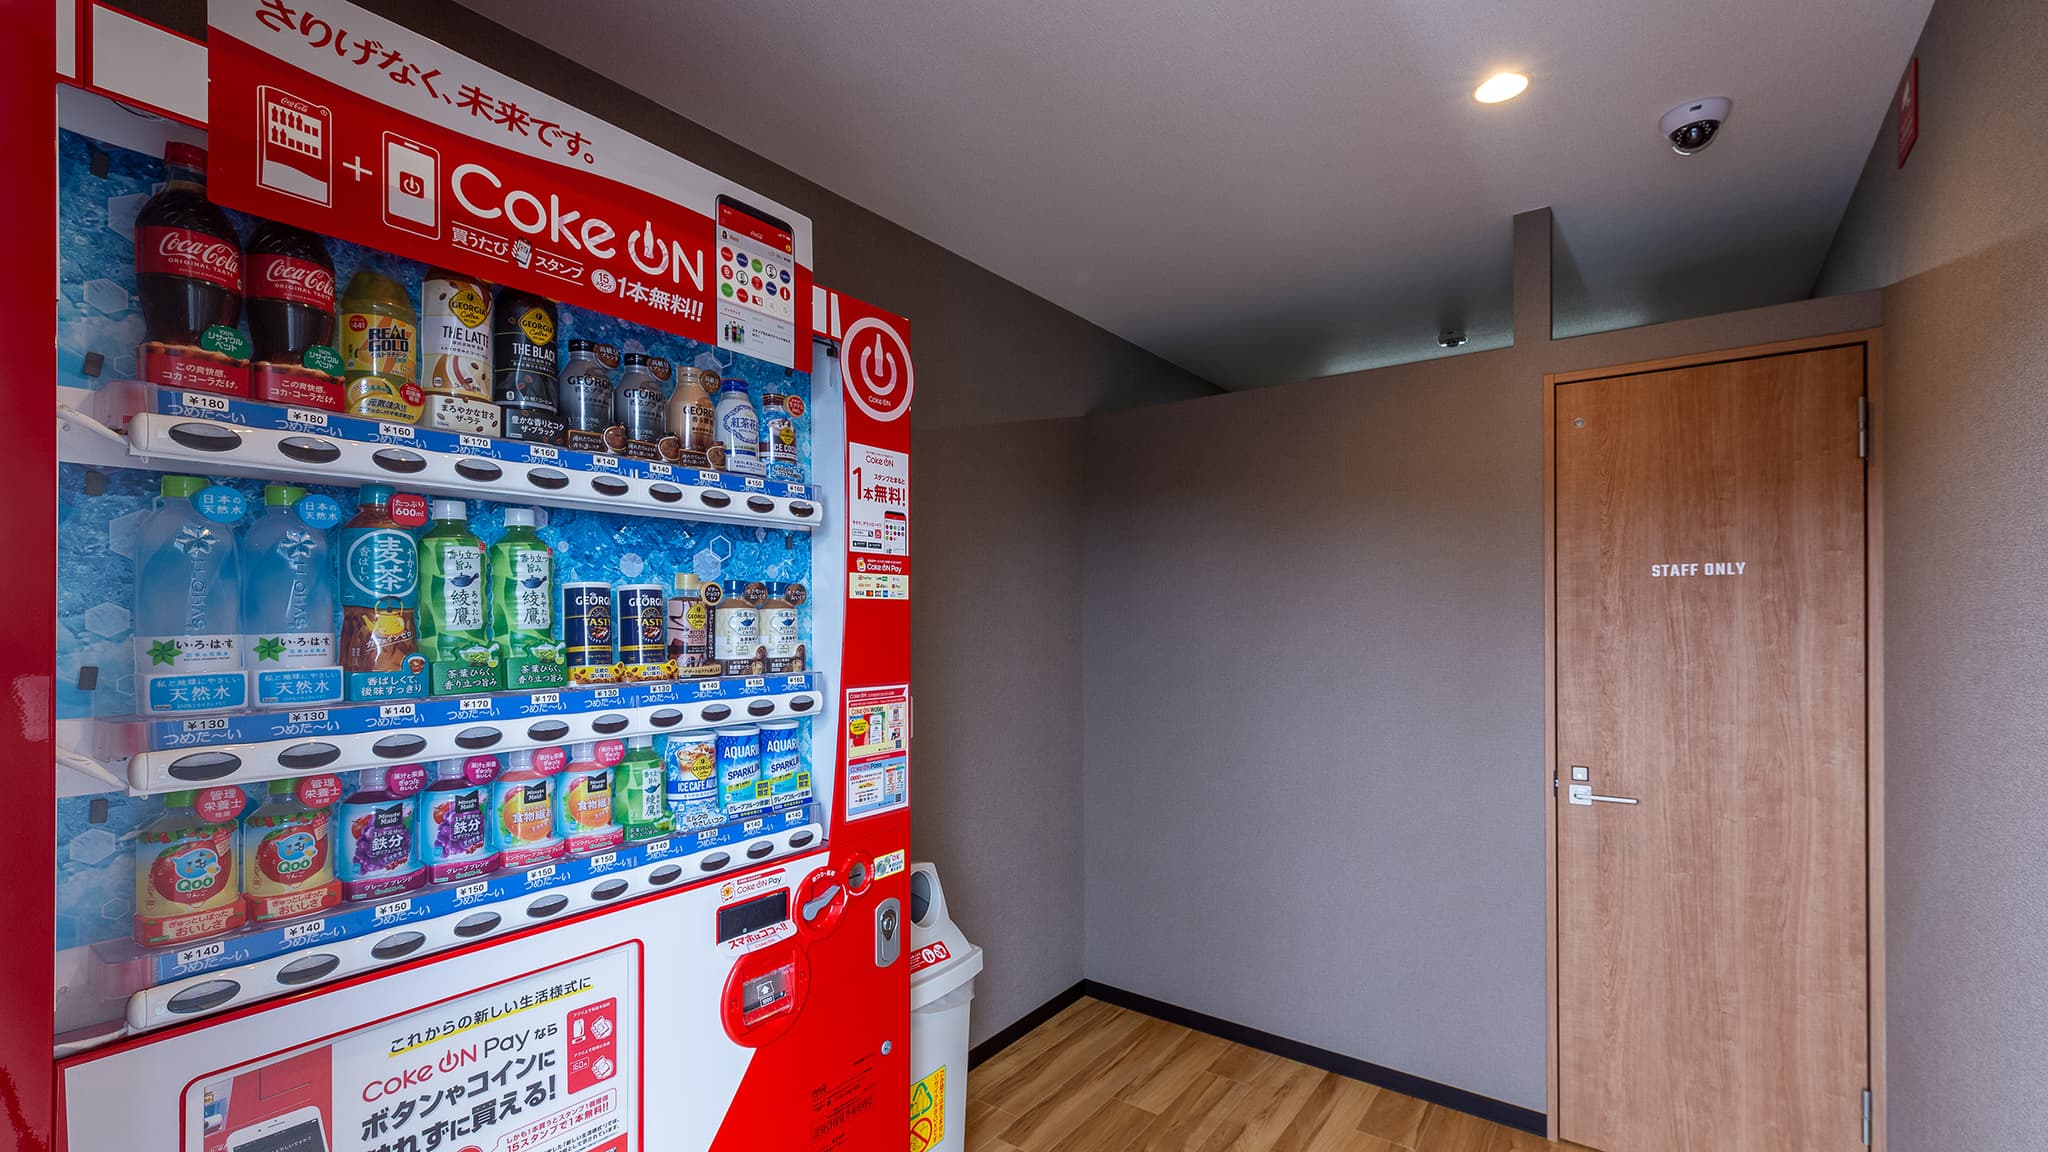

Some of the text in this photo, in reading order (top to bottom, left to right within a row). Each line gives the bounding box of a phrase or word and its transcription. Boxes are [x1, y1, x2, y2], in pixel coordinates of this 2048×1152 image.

[256, 0, 595, 165] さりげなく、未来です。
[451, 163, 616, 259] Coke
[452, 226, 509, 256] 買うたび
[159, 231, 239, 274] Coca-Cola
[167, 256, 210, 272] ORIGINAL
[535, 256, 585, 279] スタンプ
[266, 258, 336, 298] Coca-Cola
[598, 272, 610, 284] 15
[274, 282, 312, 295] ORIGINAL
[451, 300, 487, 316] GEORGIA
[459, 310, 480, 320] Coffee
[368, 325, 409, 340] REAL
[442, 325, 463, 341] THE
[522, 320, 553, 334] GEORGIA
[207, 331, 244, 346] リサイクル
[528, 329, 549, 338] Coffee
[214, 341, 238, 352] ペット
[368, 340, 409, 352] GOLD
[512, 342, 531, 357] THE
[309, 351, 339, 365] リサイクル
[175, 362, 227, 379] この爽快感。
[314, 360, 335, 370] ペット
[189, 395, 225, 410] ¥180
[293, 411, 324, 425] ¥180
[441, 404, 496, 421] まろやかな甘さ
[455, 414, 481, 426] ザ・ラテ
[511, 415, 565, 432] 豊かな香りとコク
[383, 425, 411, 437] ¥160
[462, 436, 488, 447] ¥170
[533, 447, 556, 458] ¥160
[596, 456, 616, 466] ¥140
[865, 454, 883, 466] Coke
[652, 464, 670, 474] ¥140
[701, 473, 718, 481] ¥160
[873, 473, 905, 485] スタンプたまると
[203, 493, 242, 505] 日本の
[394, 498, 425, 509] たっぷり
[203, 504, 243, 515] 天然水
[304, 501, 337, 512] 日本の
[395, 507, 425, 518] 600ml
[304, 511, 338, 522] 天然水
[448, 549, 481, 561] 香り立つ
[519, 552, 549, 564] 香り立つ
[358, 547, 370, 582] 香ばしい
[373, 536, 403, 592] 麦茶
[455, 560, 473, 571] 旨み
[526, 562, 543, 573] 旨み
[866, 563, 881, 571] Coke
[891, 564, 903, 574] Pay
[1651, 561, 1746, 577] STAFF ONLY
[471, 590, 481, 625] あやたか
[540, 592, 549, 625] あやたか
[447, 669, 496, 679] 茶葉ひらく、
[519, 664, 562, 674] 茶葉ひらく、
[156, 676, 241, 688] 私と地球にやさしい
[264, 672, 338, 683] 私と地球にやさしい
[367, 673, 419, 686] 香ばしくて、
[517, 673, 565, 685] 香り立つ旨み
[275, 679, 331, 695] 天然水
[361, 683, 423, 697] 後味すっきり
[445, 678, 498, 691] 香り立つ旨み
[169, 685, 231, 703] 天然水
[534, 694, 557, 703] ¥170
[463, 699, 489, 709] ¥170
[292, 711, 325, 721] ¥130
[384, 706, 411, 715] ¥140
[187, 719, 225, 730] ¥130
[692, 764, 712, 772] GEORGIA
[311, 777, 335, 789] 管理
[591, 784, 604, 792] Maid
[210, 789, 237, 800] 管理
[304, 786, 340, 800] 栄養士
[526, 788, 545, 797] Minute
[528, 794, 543, 802] Maid
[203, 797, 242, 813] 栄養士
[457, 798, 478, 806] Minute
[460, 803, 475, 811] Maid
[378, 811, 401, 821] Minute
[380, 817, 399, 825] Maid
[685, 813, 709, 823] ミルクの
[692, 816, 725, 828] やさしいコク
[453, 819, 481, 836] 鉄分
[746, 820, 761, 829] ¥140
[700, 831, 717, 839] ¥130
[371, 835, 404, 852] 鉄分
[649, 841, 668, 851] ¥140
[277, 858, 310, 874] Qoo
[593, 855, 614, 866] ¥150
[286, 872, 304, 880] りんご
[530, 867, 553, 879] ¥150
[176, 876, 214, 893] Qoo
[460, 883, 485, 896] ¥150
[736, 876, 782, 895] Coke ON Pay
[186, 889, 208, 899] りんご
[271, 890, 324, 907] ぎゅっとしぼった
[278, 898, 320, 915] おいしさ
[378, 902, 407, 915] ¥150
[168, 910, 229, 929] ぎゅっとしぼった
[175, 919, 223, 937] おいしさ
[289, 921, 321, 937] ¥140
[727, 922, 789, 950] スマホはココへ!!
[183, 944, 220, 961] ¥140
[761, 995, 773, 1005] 1000
[391, 976, 592, 1054] これからの新しい生活様式に
[362, 1022, 559, 1103] Coke ON Pay なら
[361, 1049, 556, 1142] ボタンやコインに
